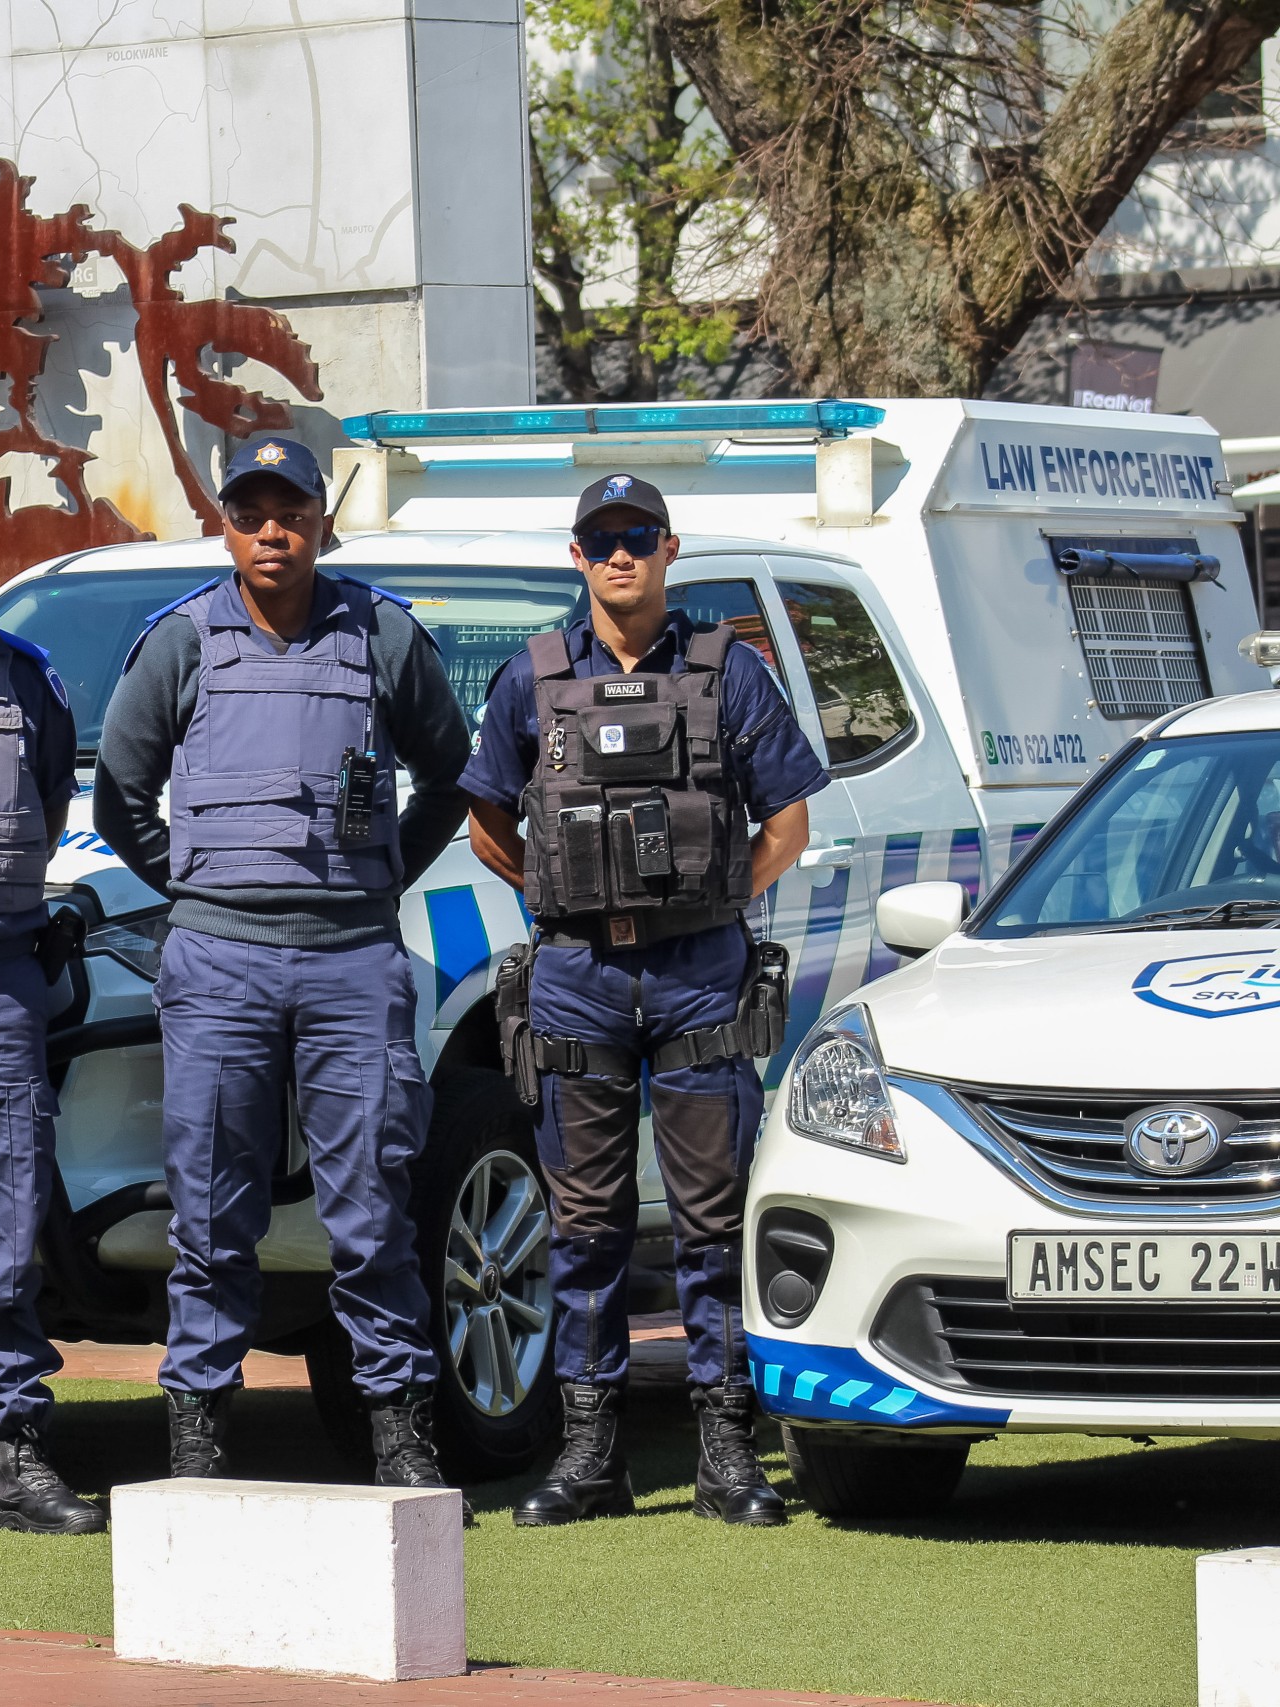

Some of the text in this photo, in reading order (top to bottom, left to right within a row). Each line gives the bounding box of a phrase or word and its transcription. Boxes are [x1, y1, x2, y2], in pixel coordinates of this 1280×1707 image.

[106, 47, 168, 62] POLOKWANE
[980, 442, 1217, 501] LAW ENFORCEMENT
[607, 685, 642, 695] WANZA
[997, 733, 1086, 765] 079 622 4722
[1192, 991, 1261, 1000] SRA
[1029, 1241, 1160, 1292] AMSEC
